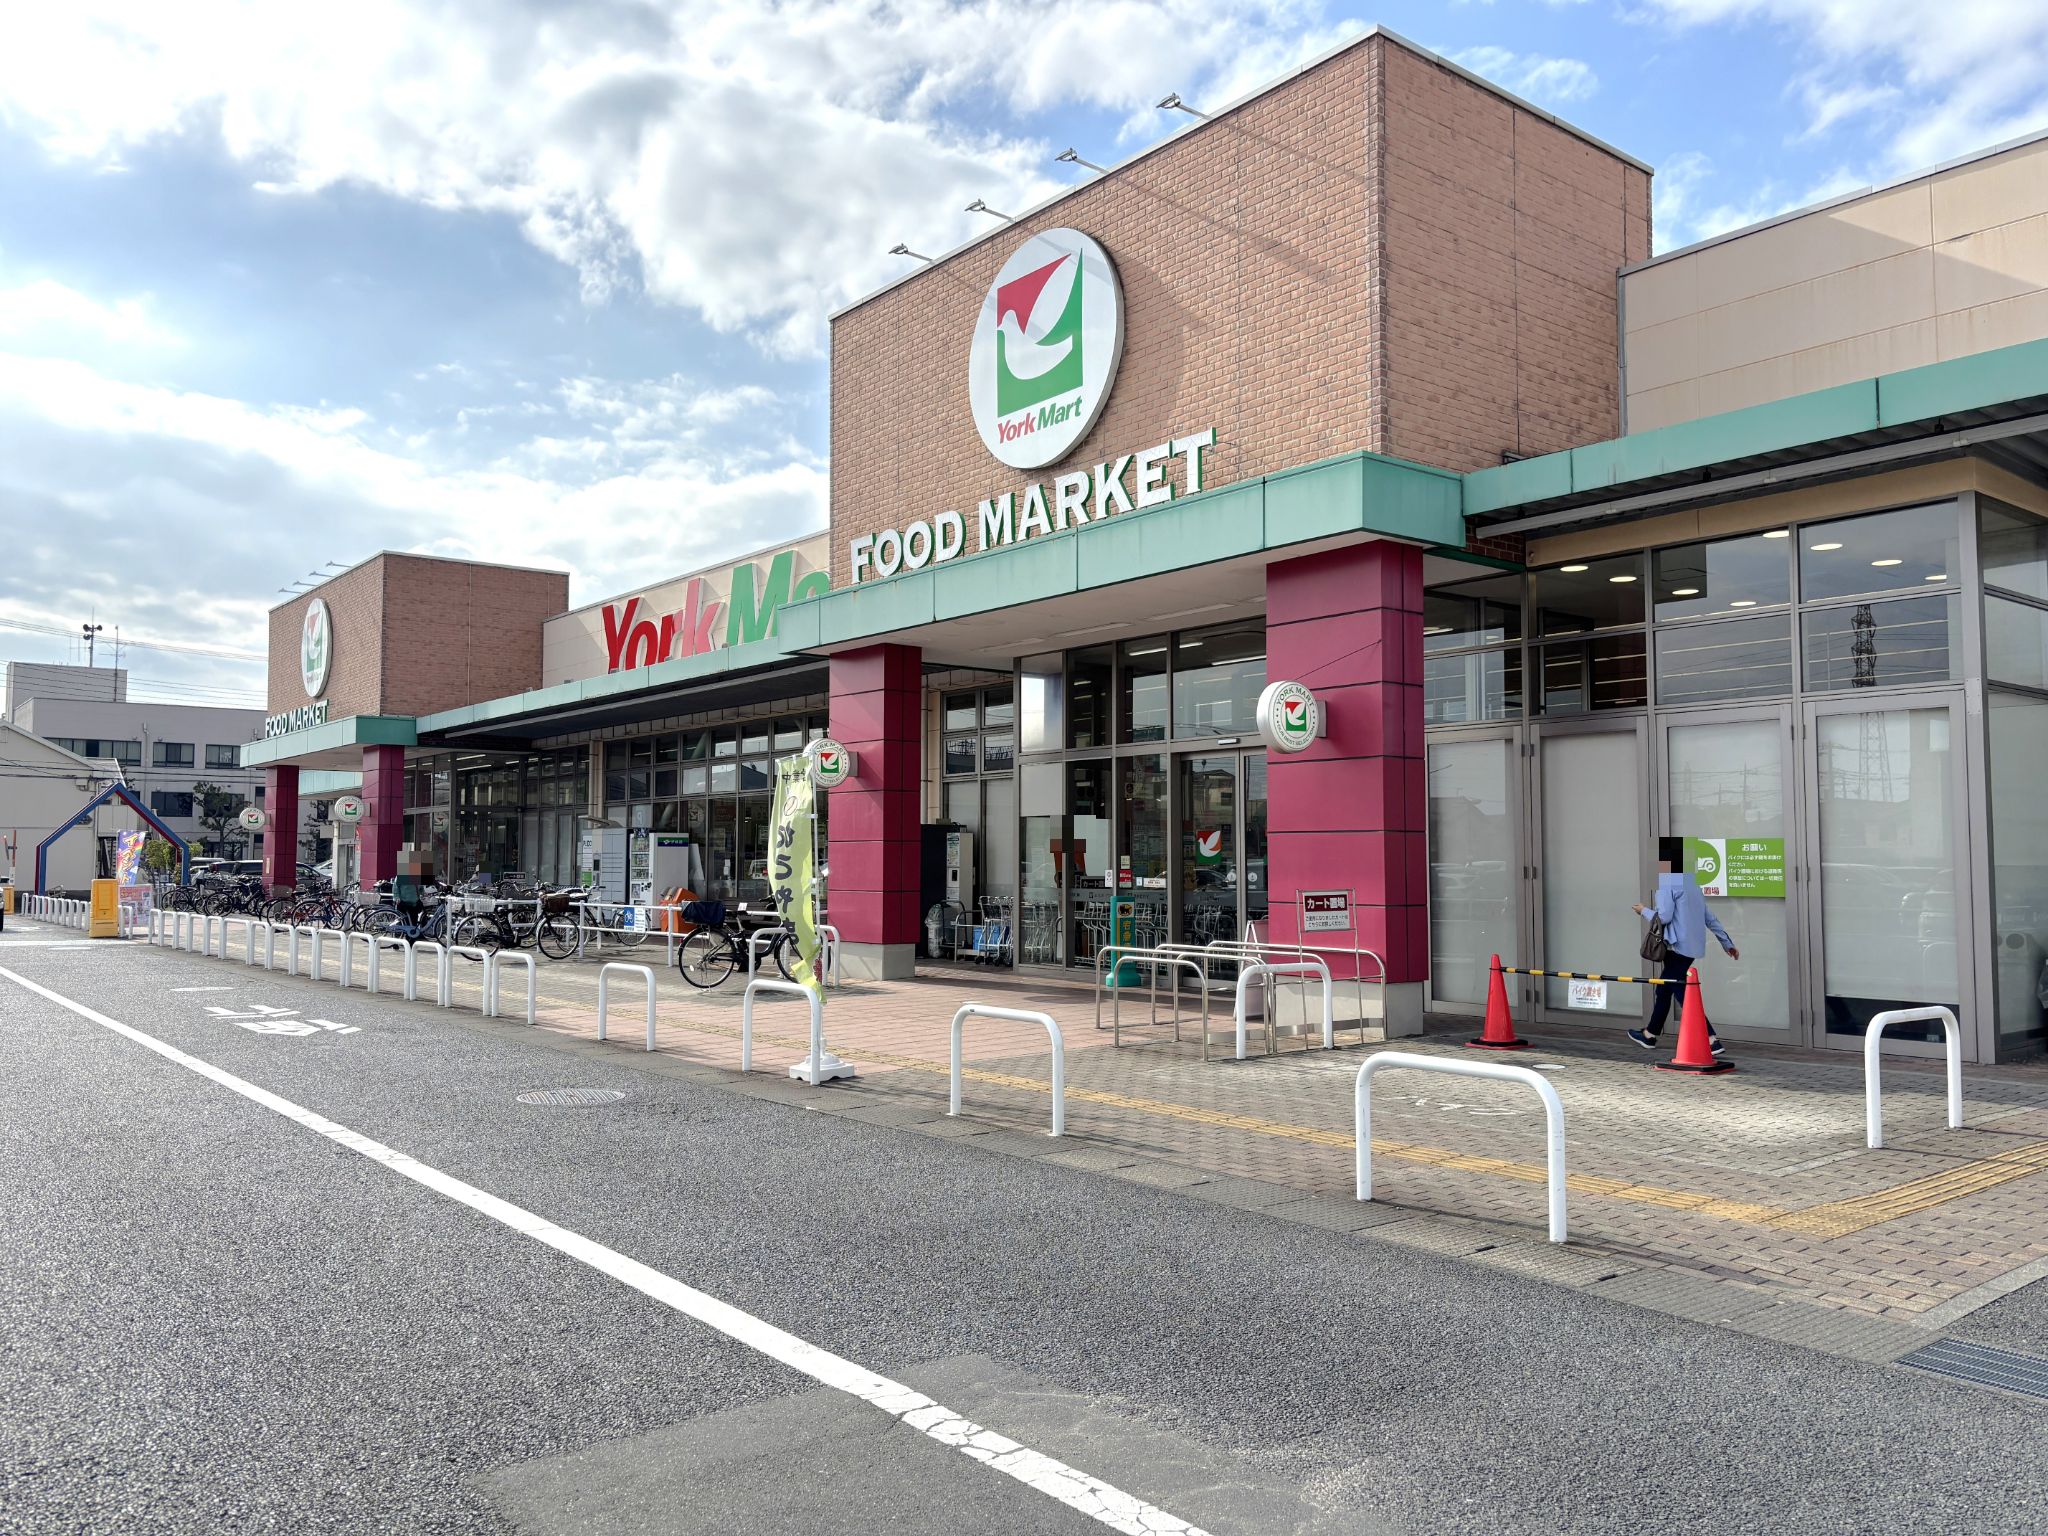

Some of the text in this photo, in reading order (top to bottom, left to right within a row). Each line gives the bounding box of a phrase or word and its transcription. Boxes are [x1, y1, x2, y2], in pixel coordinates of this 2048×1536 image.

[997, 395, 1083, 444] York Mart
[850, 427, 1216, 584] FOOD MARKET
[601, 577, 724, 674] York
[1277, 686, 1315, 706] YORK MART
[265, 699, 329, 738] FOOD MARKET
[1082, 880, 1105, 888] カート置
[1306, 896, 1346, 909] カート置場
